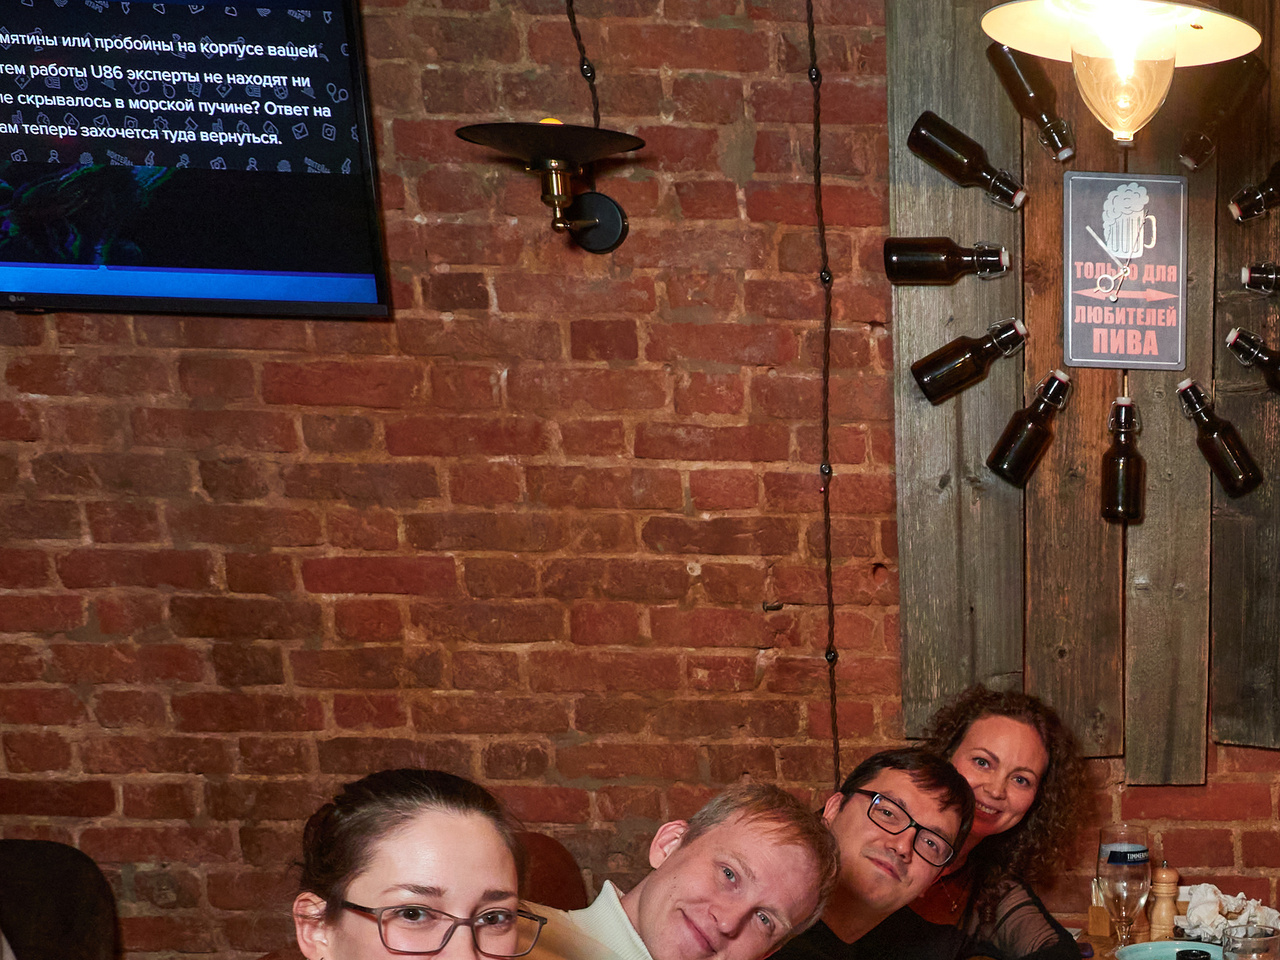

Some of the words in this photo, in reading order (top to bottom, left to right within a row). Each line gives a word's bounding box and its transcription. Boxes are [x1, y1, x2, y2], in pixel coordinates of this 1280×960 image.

[62, 36, 91, 48] или
[94, 36, 174, 52] пробоины
[178, 41, 196, 53] на
[200, 42, 264, 57] корпусе
[267, 44, 318, 58] вашей
[30, 63, 87, 78] работы
[90, 64, 123, 79] U86
[127, 69, 200, 84] эксперты
[204, 72, 223, 84] не
[227, 73, 288, 88] находят
[292, 76, 311, 87] ни
[18, 94, 112, 108] скрывалось
[115, 98, 125, 109] в
[129, 99, 194, 113] морской
[199, 101, 260, 115] пучине?
[264, 101, 309, 117] Ответ
[313, 105, 331, 117] на
[22, 124, 77, 138] теперь
[80, 126, 159, 140] захочется
[162, 129, 196, 143] туда
[200, 131, 282, 146] вернуться.
[1074, 261, 1138, 281] ТОЛЬО
[1142, 264, 1177, 284] ДЛЯ
[1074, 305, 1177, 327] ЛЮБИТЕЛЕЙ
[1092, 328, 1159, 356] ПИВА
